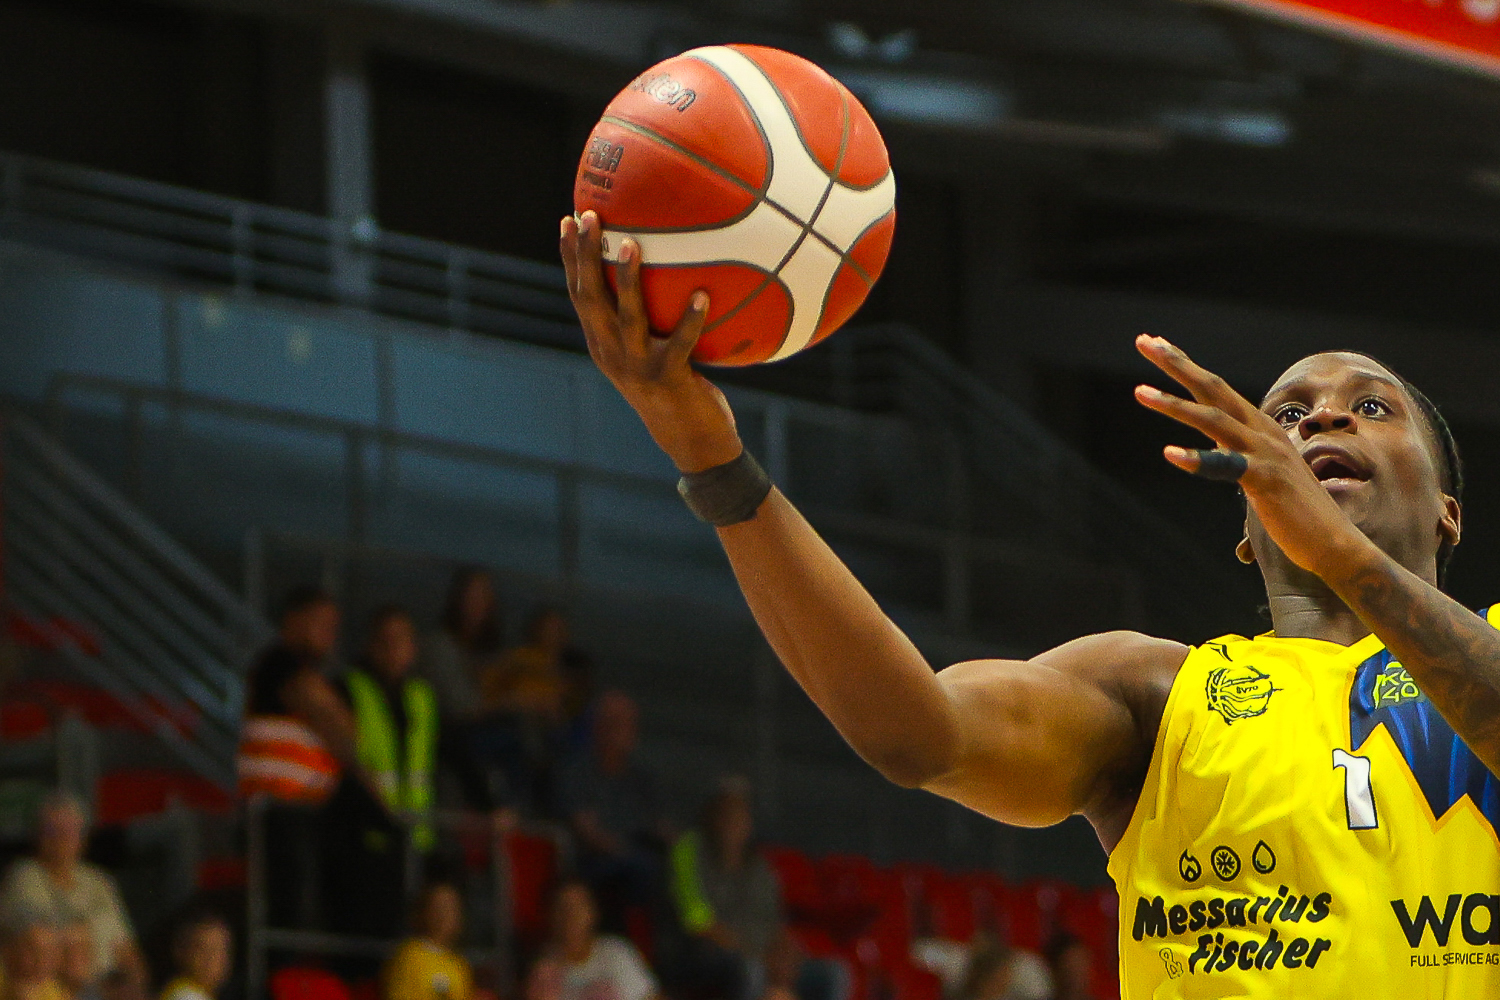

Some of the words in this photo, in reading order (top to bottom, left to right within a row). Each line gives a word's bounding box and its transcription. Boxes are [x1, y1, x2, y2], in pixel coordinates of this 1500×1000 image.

[1381, 682, 1419, 702] 40
[1332, 748, 1379, 830] 1
[1132, 884, 1332, 942] Messarius
[1158, 947, 1184, 979] &
[1188, 928, 1332, 975] Fischer
[1410, 953, 1440, 967] FULL
[1442, 952, 1483, 966] SERVICE
